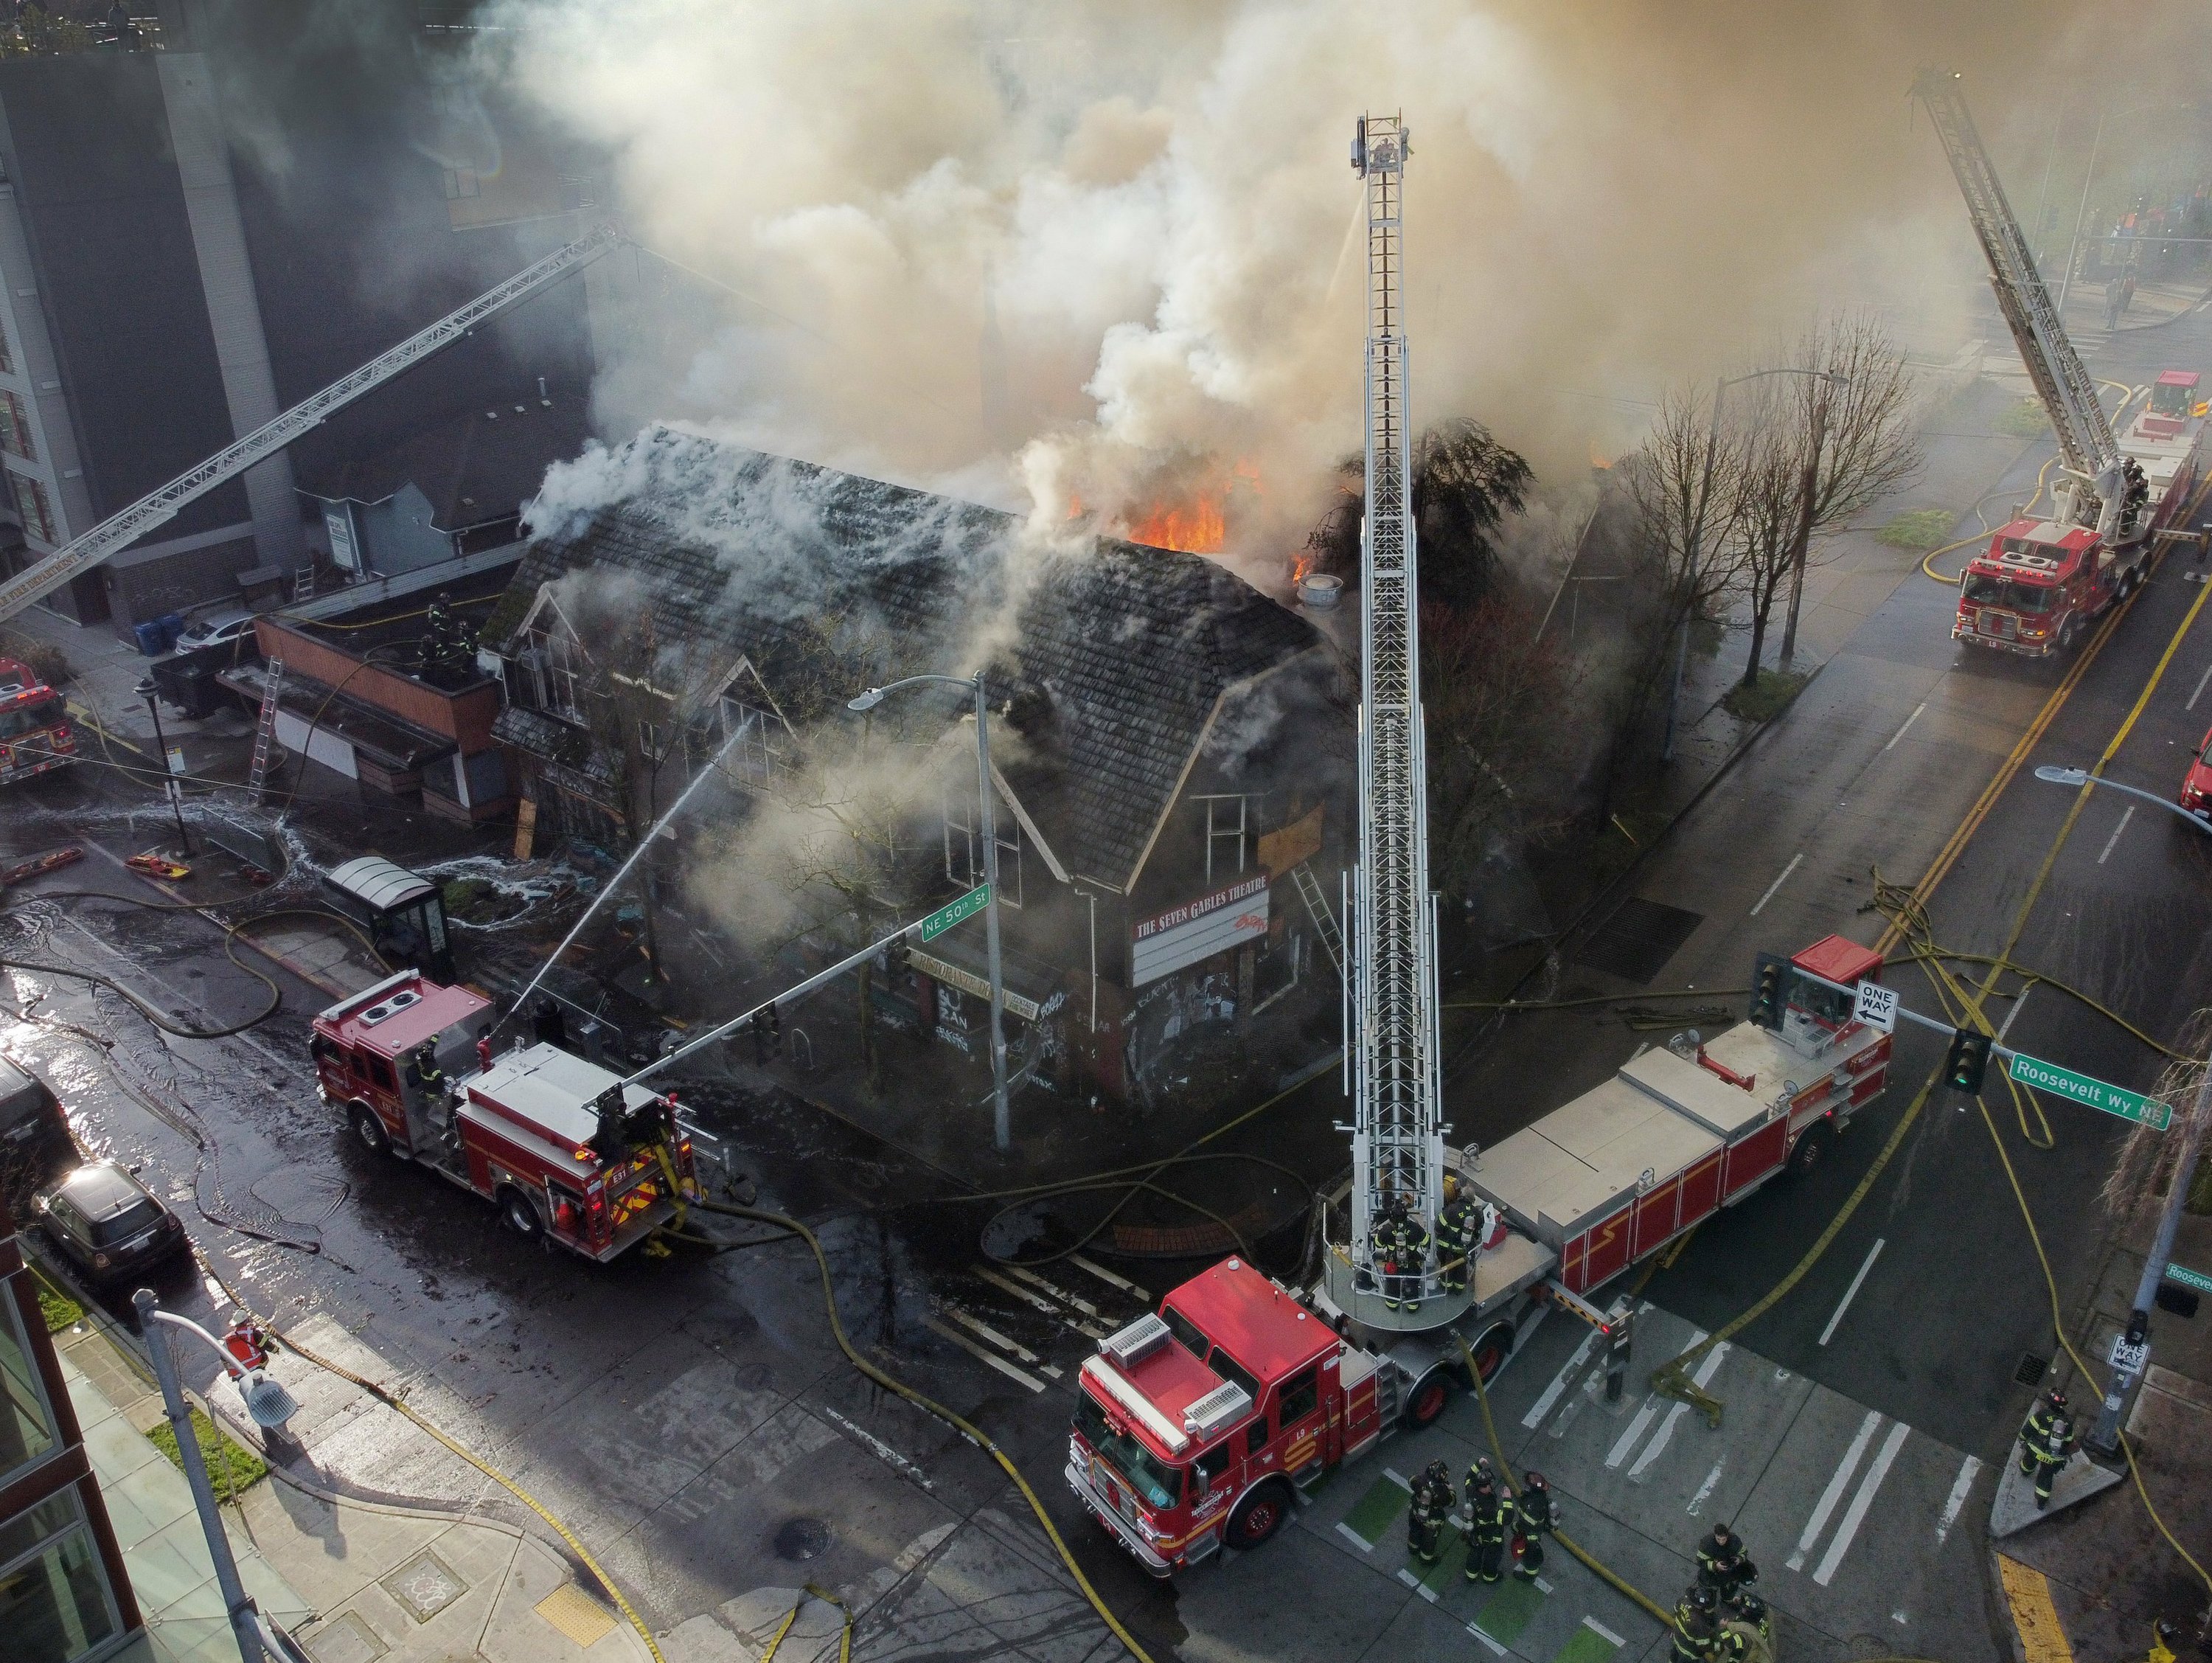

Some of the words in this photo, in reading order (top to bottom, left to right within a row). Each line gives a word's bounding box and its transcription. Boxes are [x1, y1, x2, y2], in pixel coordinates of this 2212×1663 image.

[2074, 361, 2093, 394] SEATTLE
[2086, 392, 2099, 412] FIRE
[9, 584, 29, 601] FIRE
[27, 553, 79, 589] DEPARTMENT
[925, 917, 942, 934] NE
[945, 901, 969, 923] 50th
[975, 892, 986, 905] St
[1137, 919, 1156, 938] THE
[1159, 906, 1188, 932] SEVEN
[1190, 891, 1226, 919] GABLES
[1228, 875, 1267, 901] THEATRE
[919, 954, 978, 989] RISTORANTE
[1862, 996, 1891, 1013] WAY
[1863, 986, 1892, 1004] ONE
[2016, 1060, 2102, 1103] Roosevelt
[2107, 1093, 2132, 1114] Wy
[2138, 1103, 2165, 1123] NE
[612, 1168, 627, 1184] E31
[2115, 1347, 2142, 1362] WAY
[1295, 1428, 1306, 1442] L9
